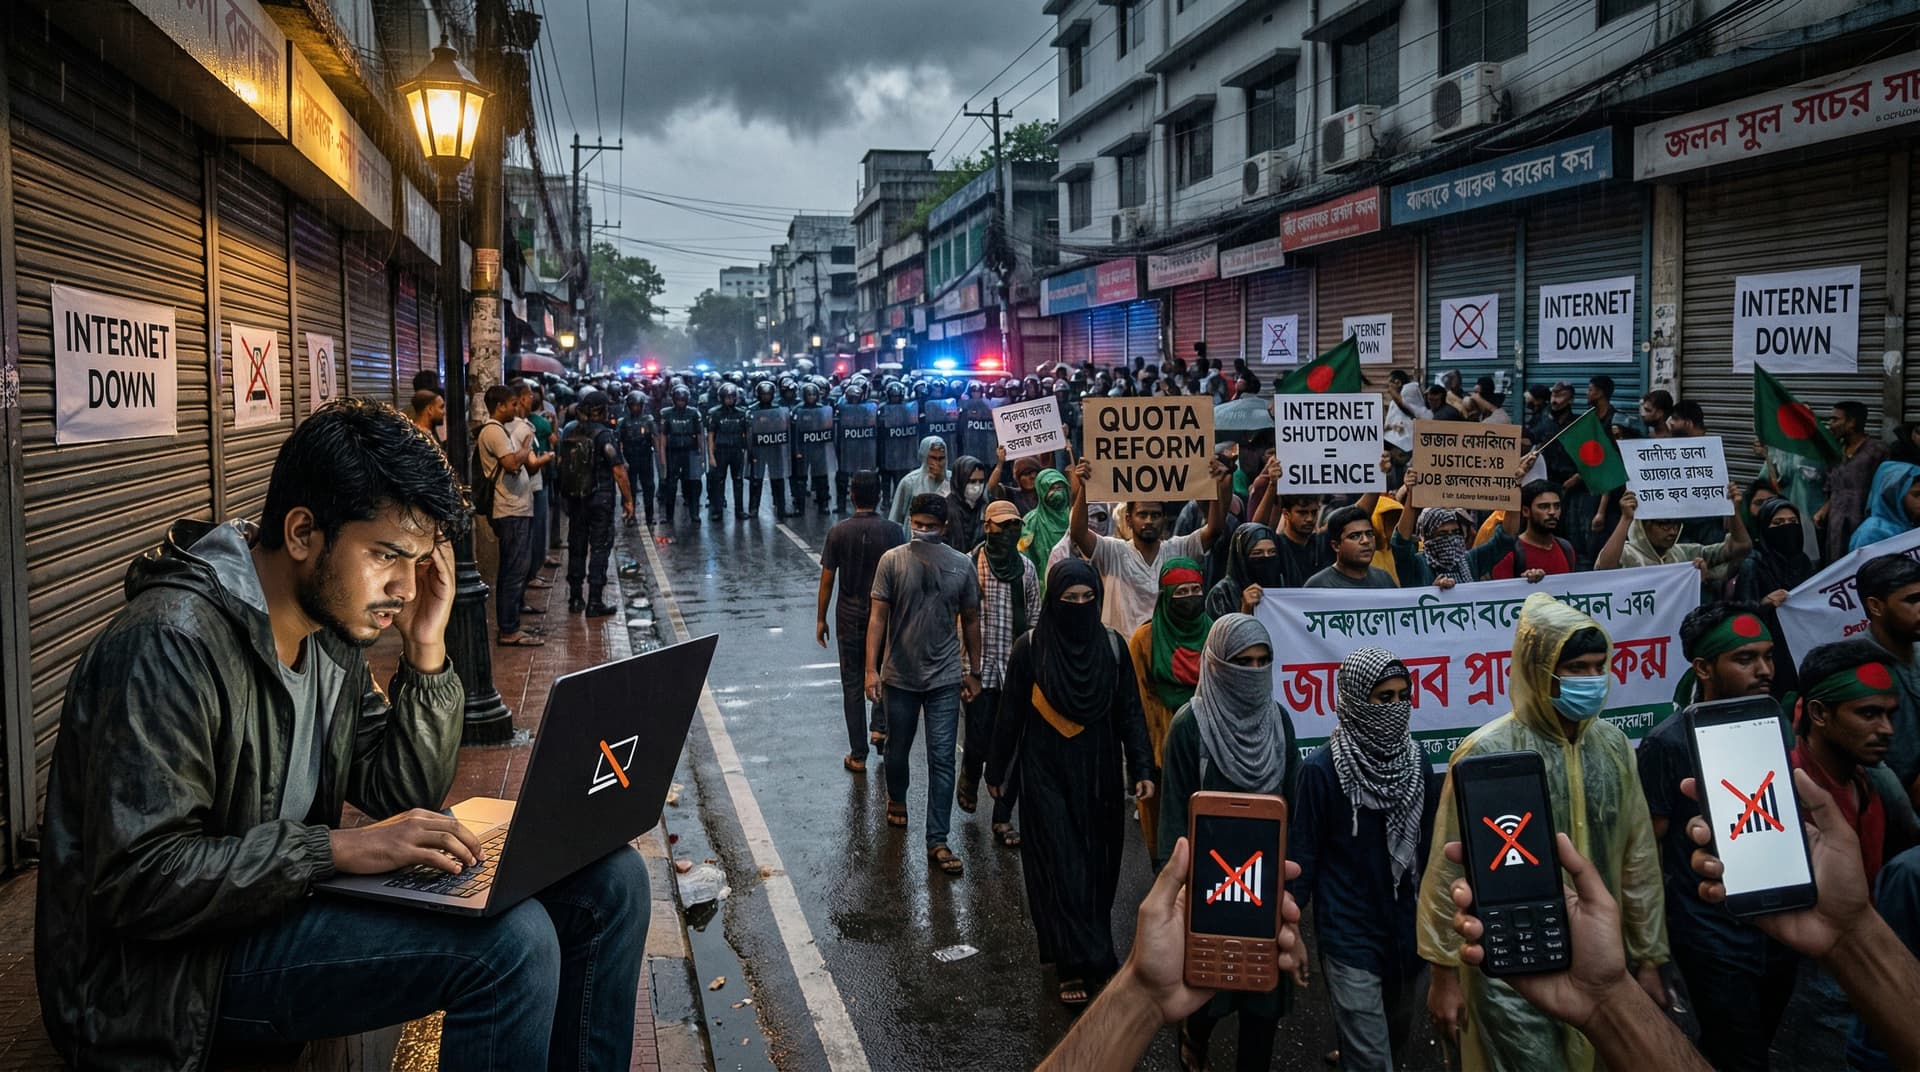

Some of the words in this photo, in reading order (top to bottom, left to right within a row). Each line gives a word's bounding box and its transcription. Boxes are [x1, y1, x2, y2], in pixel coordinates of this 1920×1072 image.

[1544, 289, 1632, 319] INTERNET
[1742, 284, 1855, 317] INTERNET
[66, 311, 170, 360] INTERNET
[1348, 323, 1386, 337] INTERNET
[1556, 325, 1614, 351] DOWN
[1359, 340, 1380, 354] OWN
[1755, 326, 1832, 356] DOWN
[88, 369, 156, 409] DOWN
[1099, 406, 1200, 432] QUOTA
[1284, 401, 1374, 420] INTERNET
[803, 430, 832, 443] POLICE
[844, 427, 874, 439] POLICE
[889, 426, 917, 438] POLICE
[929, 422, 957, 433] POLICE
[1282, 425, 1378, 442] SHUTDOWN
[757, 432, 787, 444] POLICE
[1096, 435, 1205, 460] REFORM
[1113, 464, 1189, 493] NOW
[1288, 463, 1375, 485] SILENCE
[1417, 473, 1442, 486] JOB
